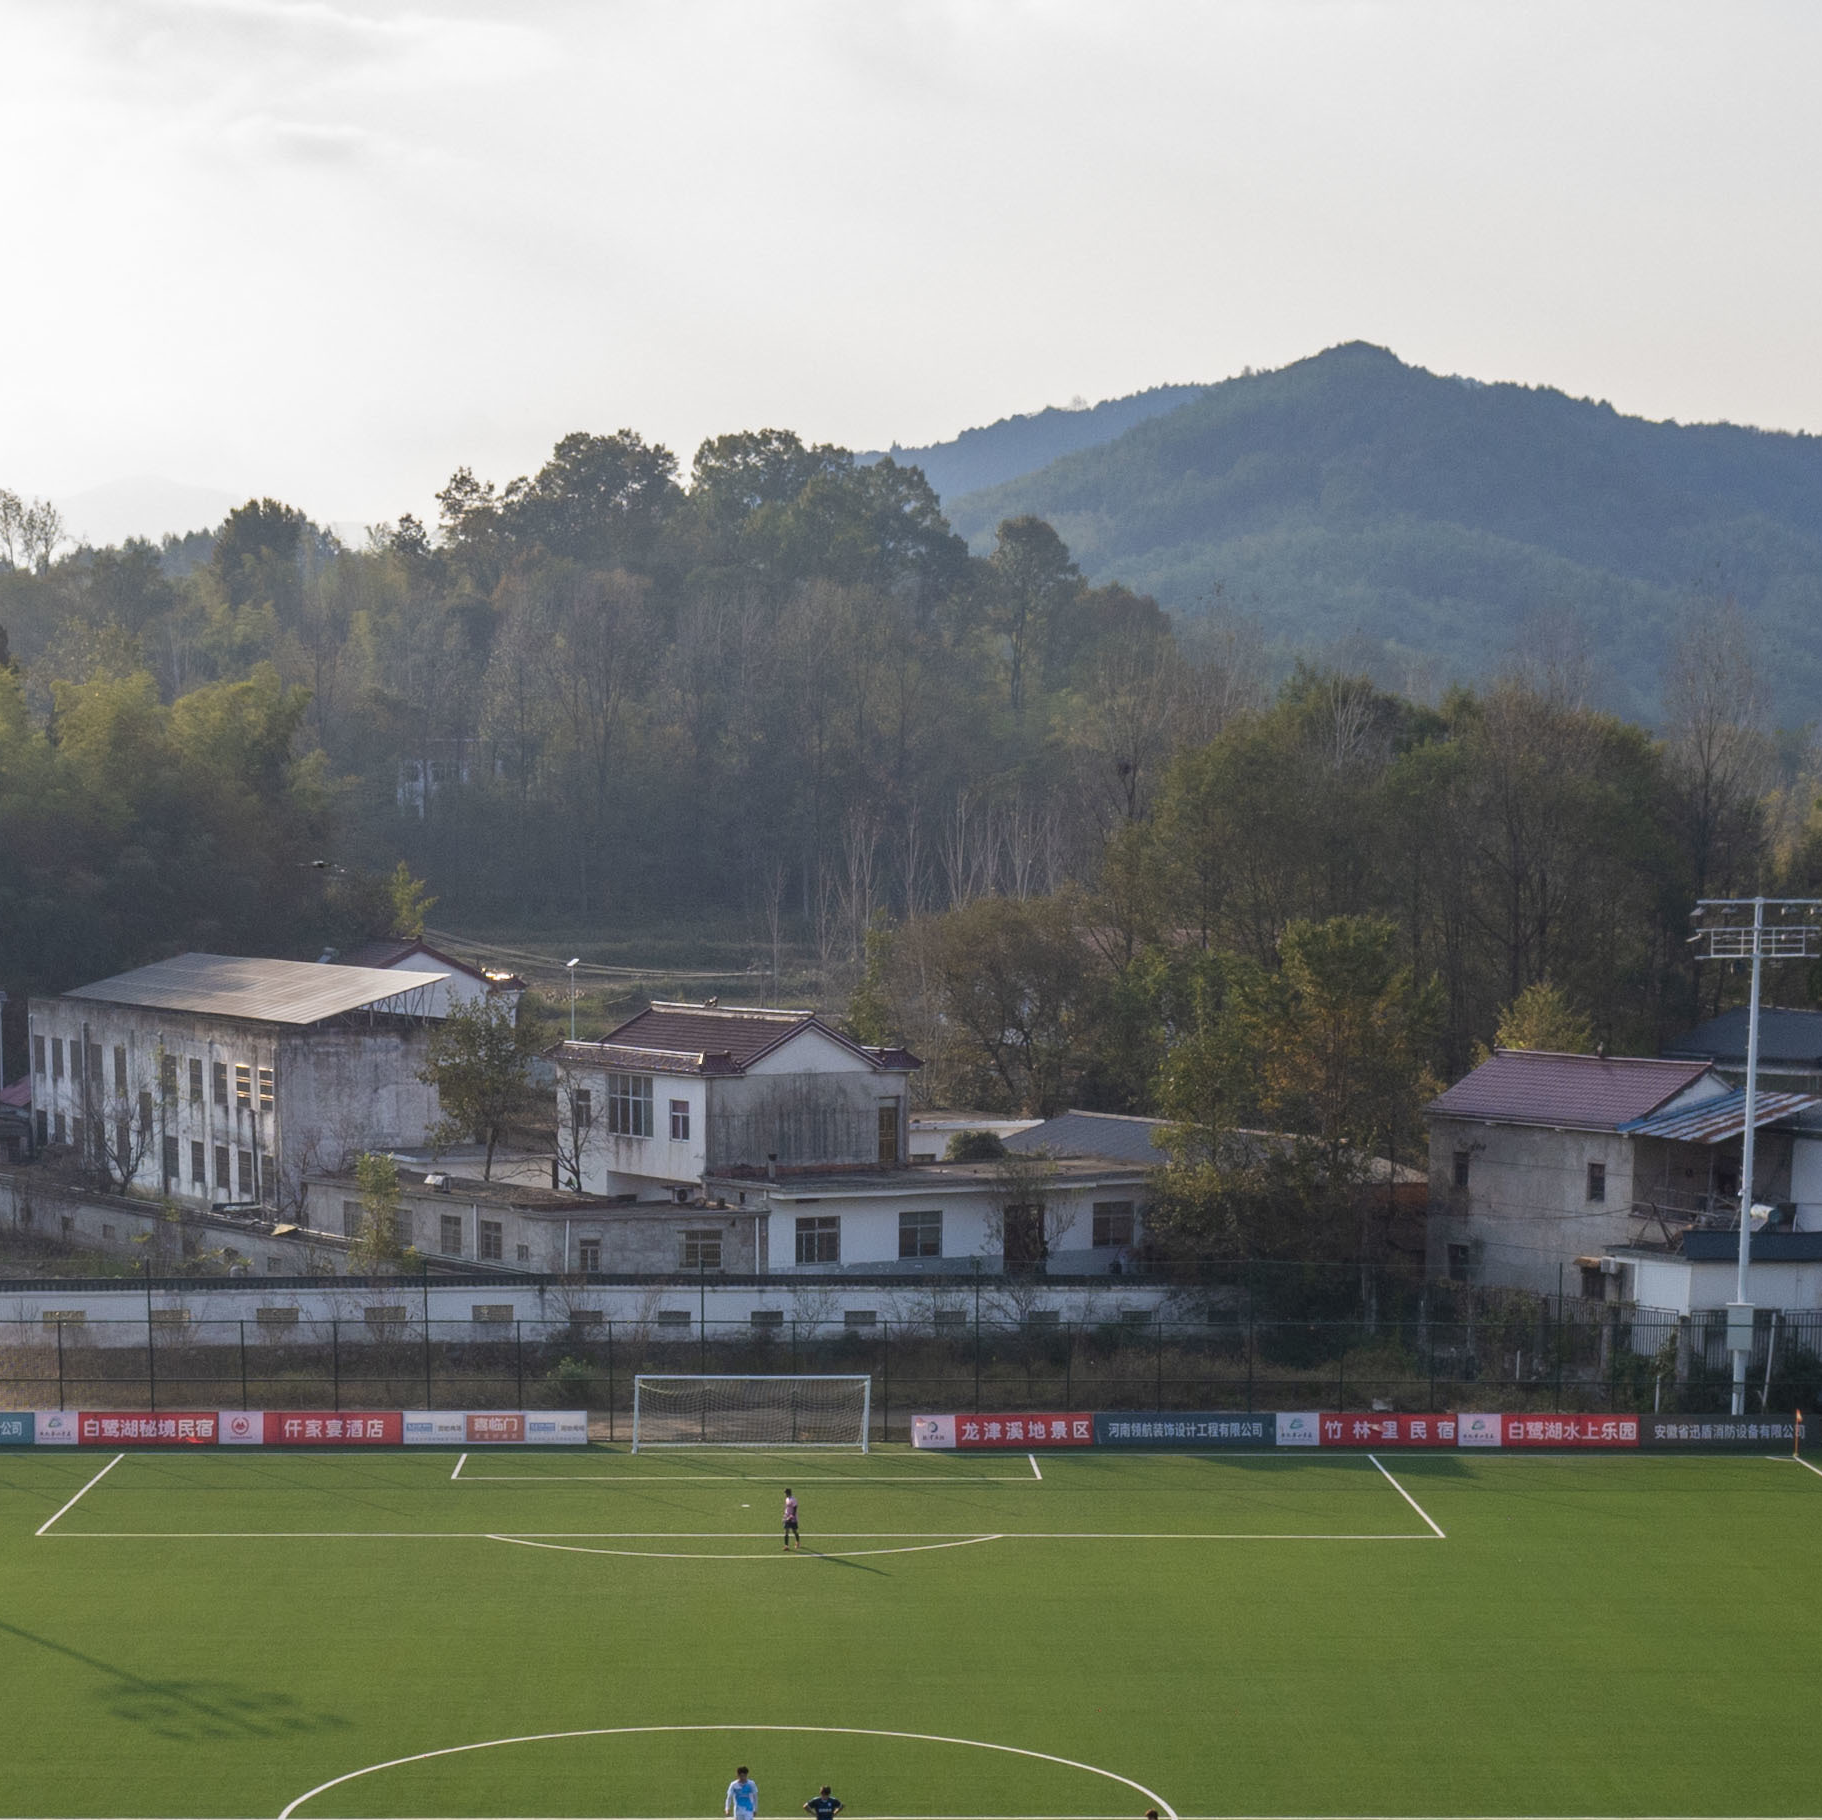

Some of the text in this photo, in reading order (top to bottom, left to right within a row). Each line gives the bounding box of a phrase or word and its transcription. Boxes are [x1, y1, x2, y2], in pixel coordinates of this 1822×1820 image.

[83, 1418, 214, 1438] 白鹭湖秘境民宿
[283, 1418, 385, 1438] 仟家宴酒店
[961, 1420, 1090, 1441] 龙津溪地景区
[1108, 1422, 1263, 1438] 河南领航装饰设计工程有限公司
[1324, 1420, 1456, 1440] 竹林里民宿
[1508, 1421, 1637, 1441] 白鹭湖水上乐园
